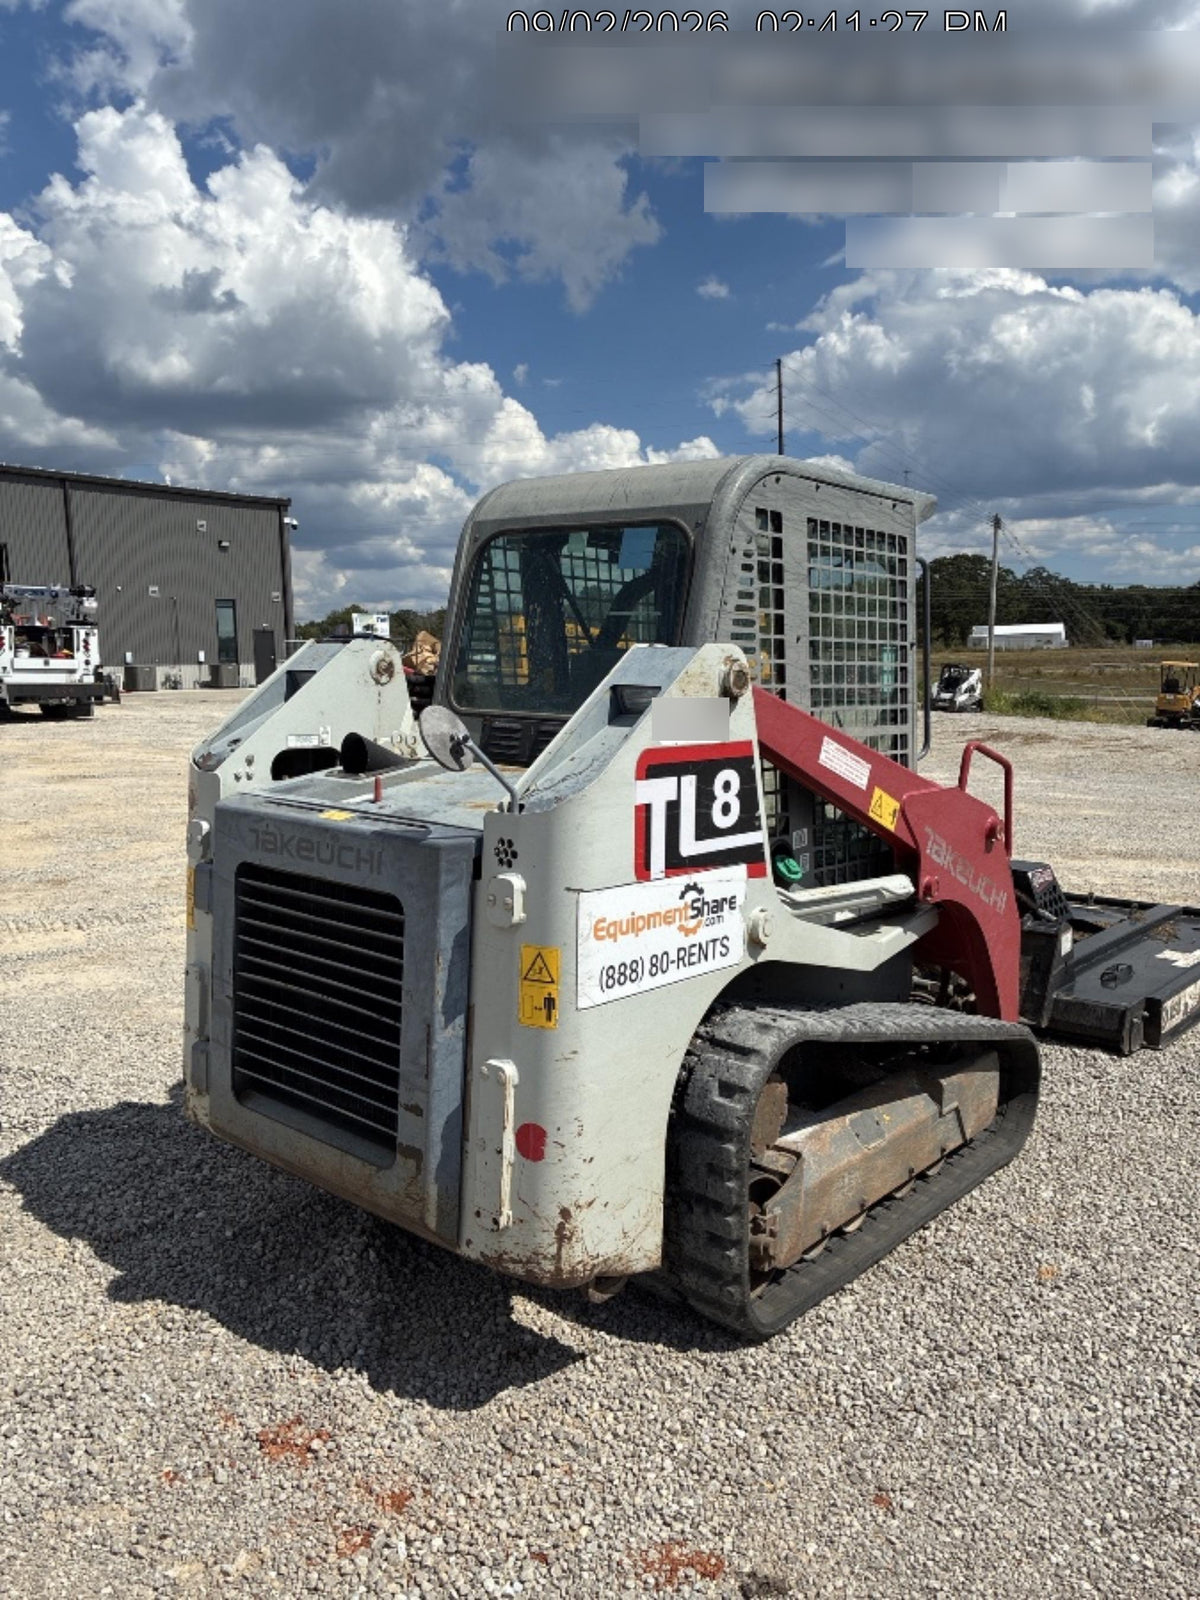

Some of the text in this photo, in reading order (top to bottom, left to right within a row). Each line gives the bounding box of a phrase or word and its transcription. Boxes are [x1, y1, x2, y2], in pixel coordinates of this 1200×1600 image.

[634, 768, 764, 880] TL8
[593, 894, 737, 943] EquipmentShare
[599, 935, 731, 993] (888) 80-RENTS
